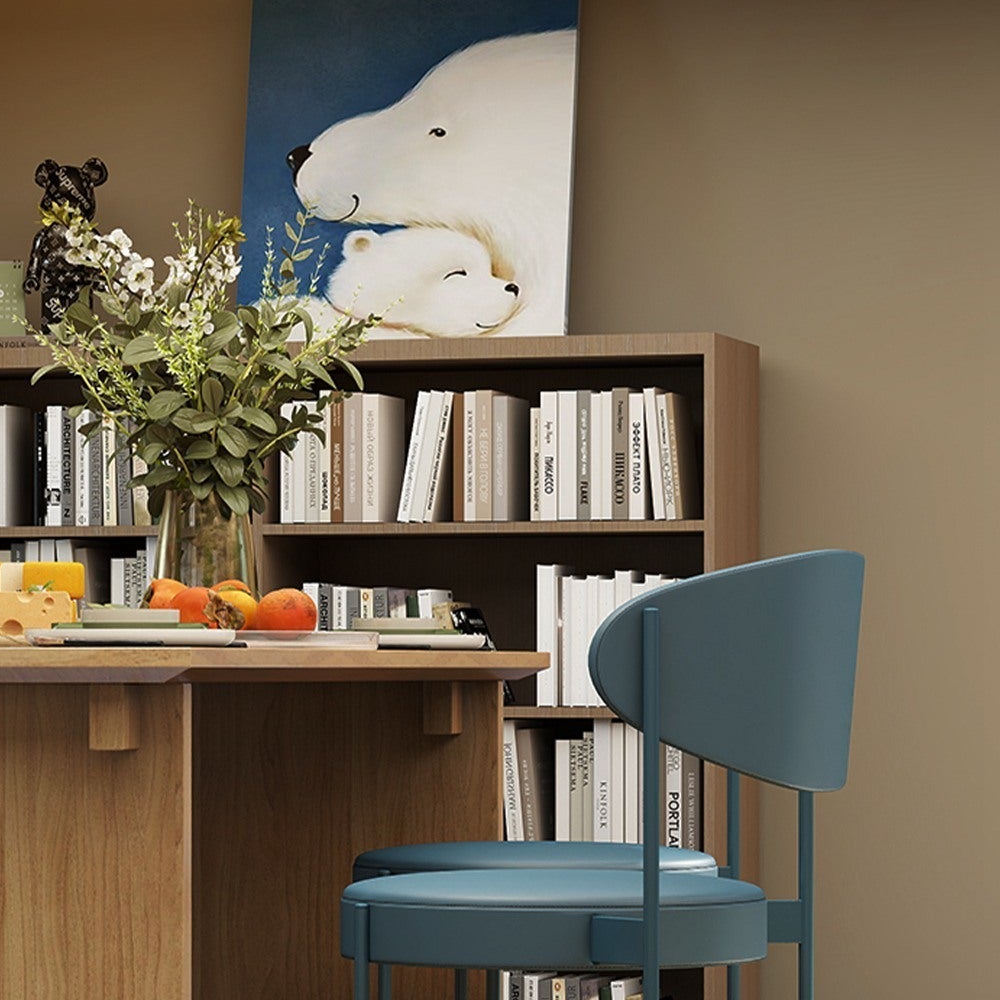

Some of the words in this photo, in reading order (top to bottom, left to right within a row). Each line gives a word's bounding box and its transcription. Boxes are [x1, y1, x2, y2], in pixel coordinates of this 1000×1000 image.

[367, 410, 375, 442] НОВЫЙ
[632, 421, 641, 460] ЭФФЕКТ
[63, 417, 71, 494] ARCHITECTURE
[367, 444, 375, 472] ОБРАЗ
[544, 456, 554, 495] ПИКАССО
[580, 481, 588, 505] FLAKE
[614, 452, 625, 505] ПИКАССО
[632, 462, 641, 494] ПЛАТО
[669, 792, 679, 848] PORTLA
